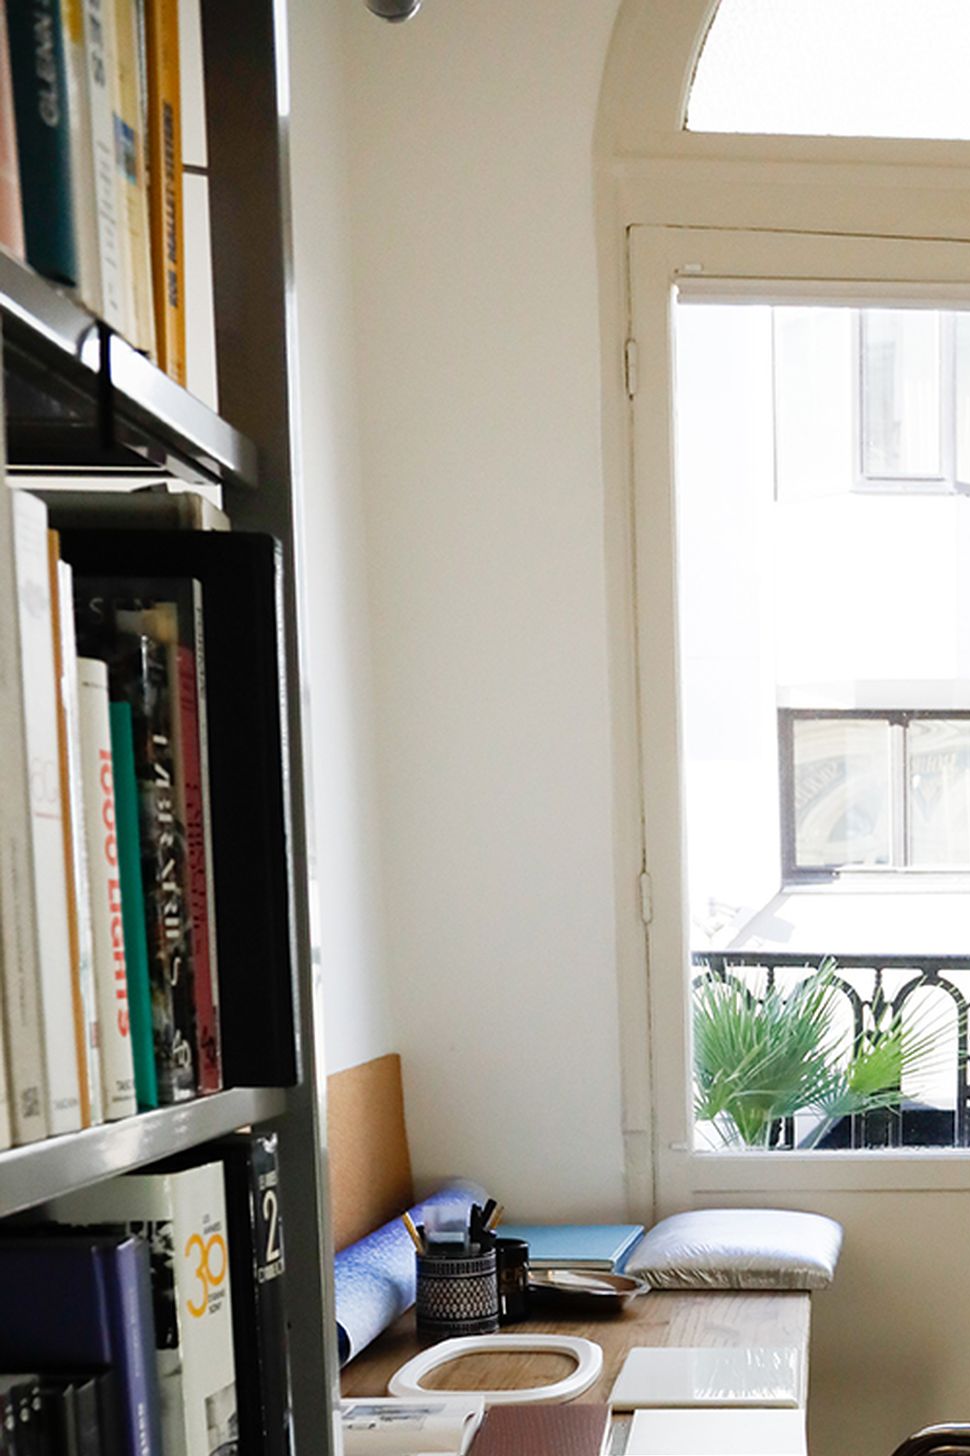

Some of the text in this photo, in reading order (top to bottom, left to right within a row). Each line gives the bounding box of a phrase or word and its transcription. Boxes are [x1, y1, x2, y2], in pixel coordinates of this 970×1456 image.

[98, 747, 130, 1038] 1000 LIGHTS
[262, 1188, 282, 1263] 2
[184, 1232, 228, 1319] 30
